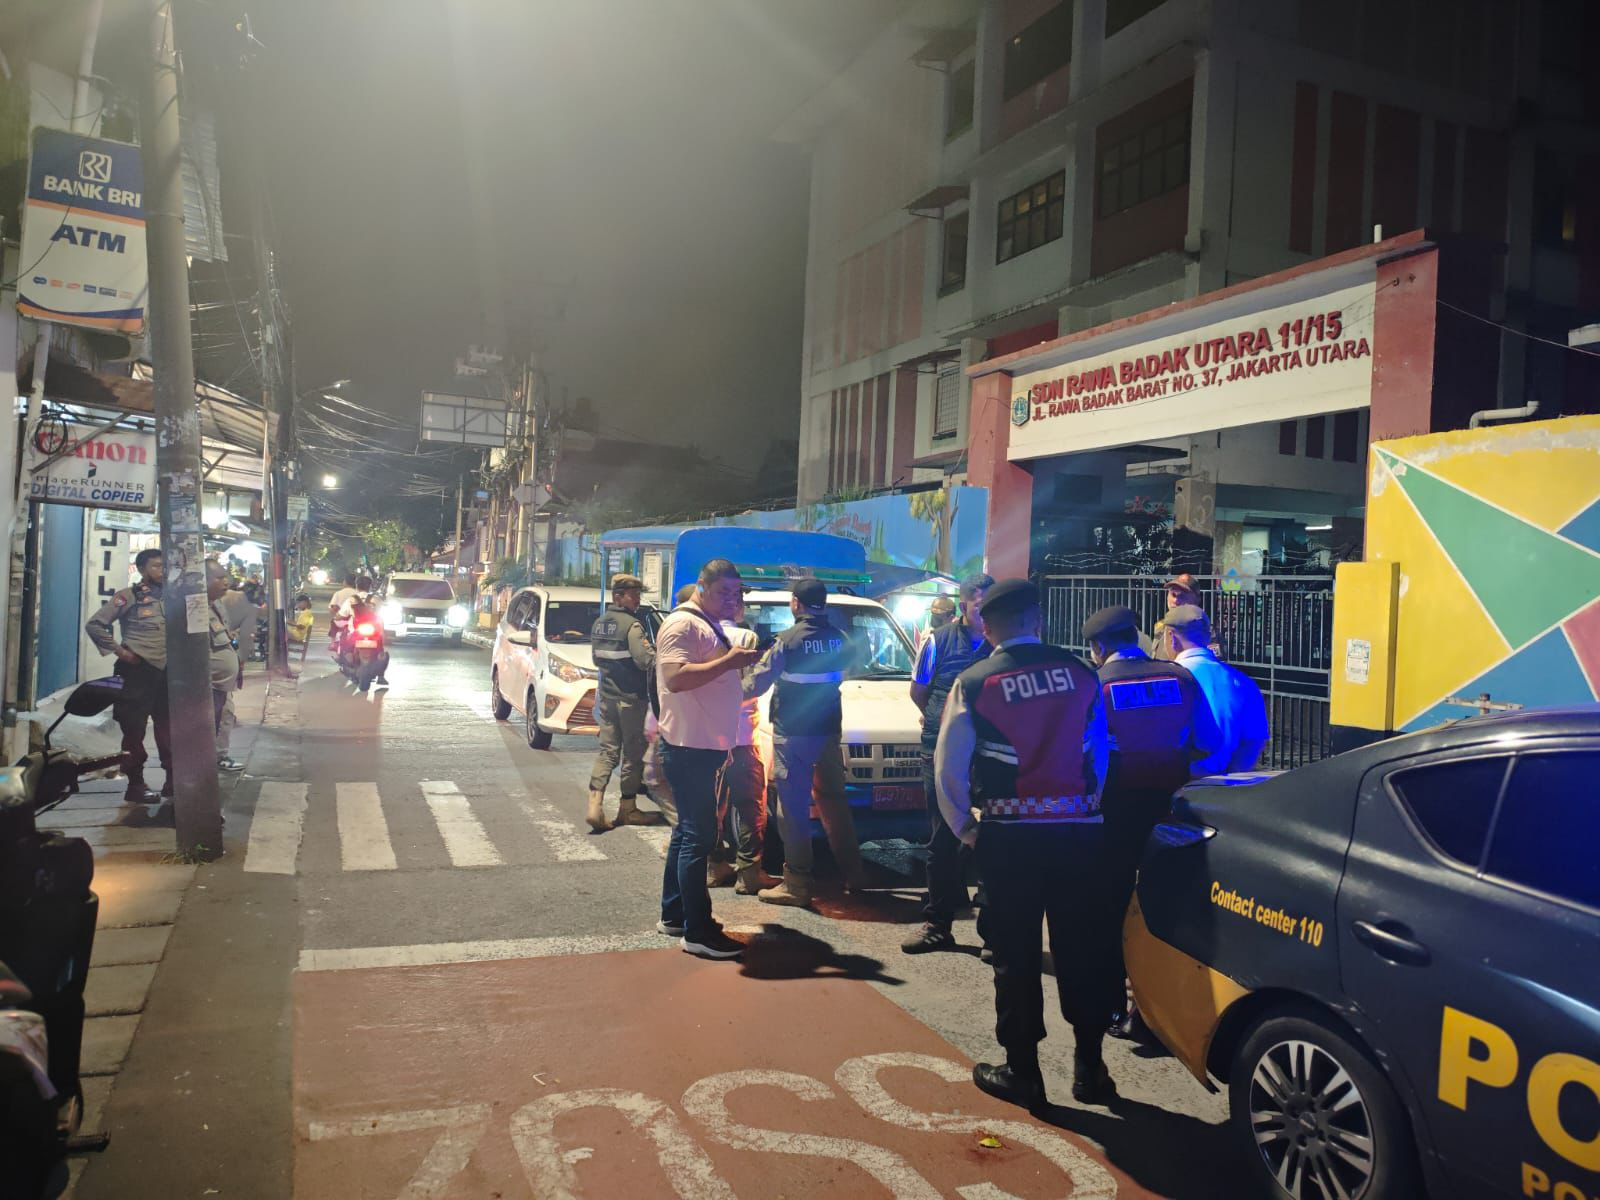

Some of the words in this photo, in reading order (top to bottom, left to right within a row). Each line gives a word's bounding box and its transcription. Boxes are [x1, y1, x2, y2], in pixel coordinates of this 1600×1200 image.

[44, 175, 104, 201] BANK
[108, 187, 141, 208] BRI
[50, 223, 127, 254] ATM
[1032, 379, 1065, 404] SDN
[1067, 366, 1117, 397] RAWA
[1120, 346, 1190, 385] BADAK
[1194, 327, 1273, 367] UTARA
[1278, 310, 1342, 349] 11/15
[1049, 398, 1081, 418] RAWA
[1082, 388, 1123, 411] BADAK
[1126, 378, 1169, 402] BARAT
[1172, 373, 1198, 392] NO.
[1201, 367, 1223, 386] 37,
[1226, 350, 1302, 382] JAKARTA
[1306, 338, 1371, 367] UTARA
[31, 483, 87, 499] DIGITAL
[91, 488, 145, 503] COPIER
[804, 640, 826, 654] POL
[1001, 668, 1075, 702] POLISI
[1210, 881, 1255, 918] Contact
[1256, 905, 1297, 935] center
[1300, 917, 1323, 947] 110
